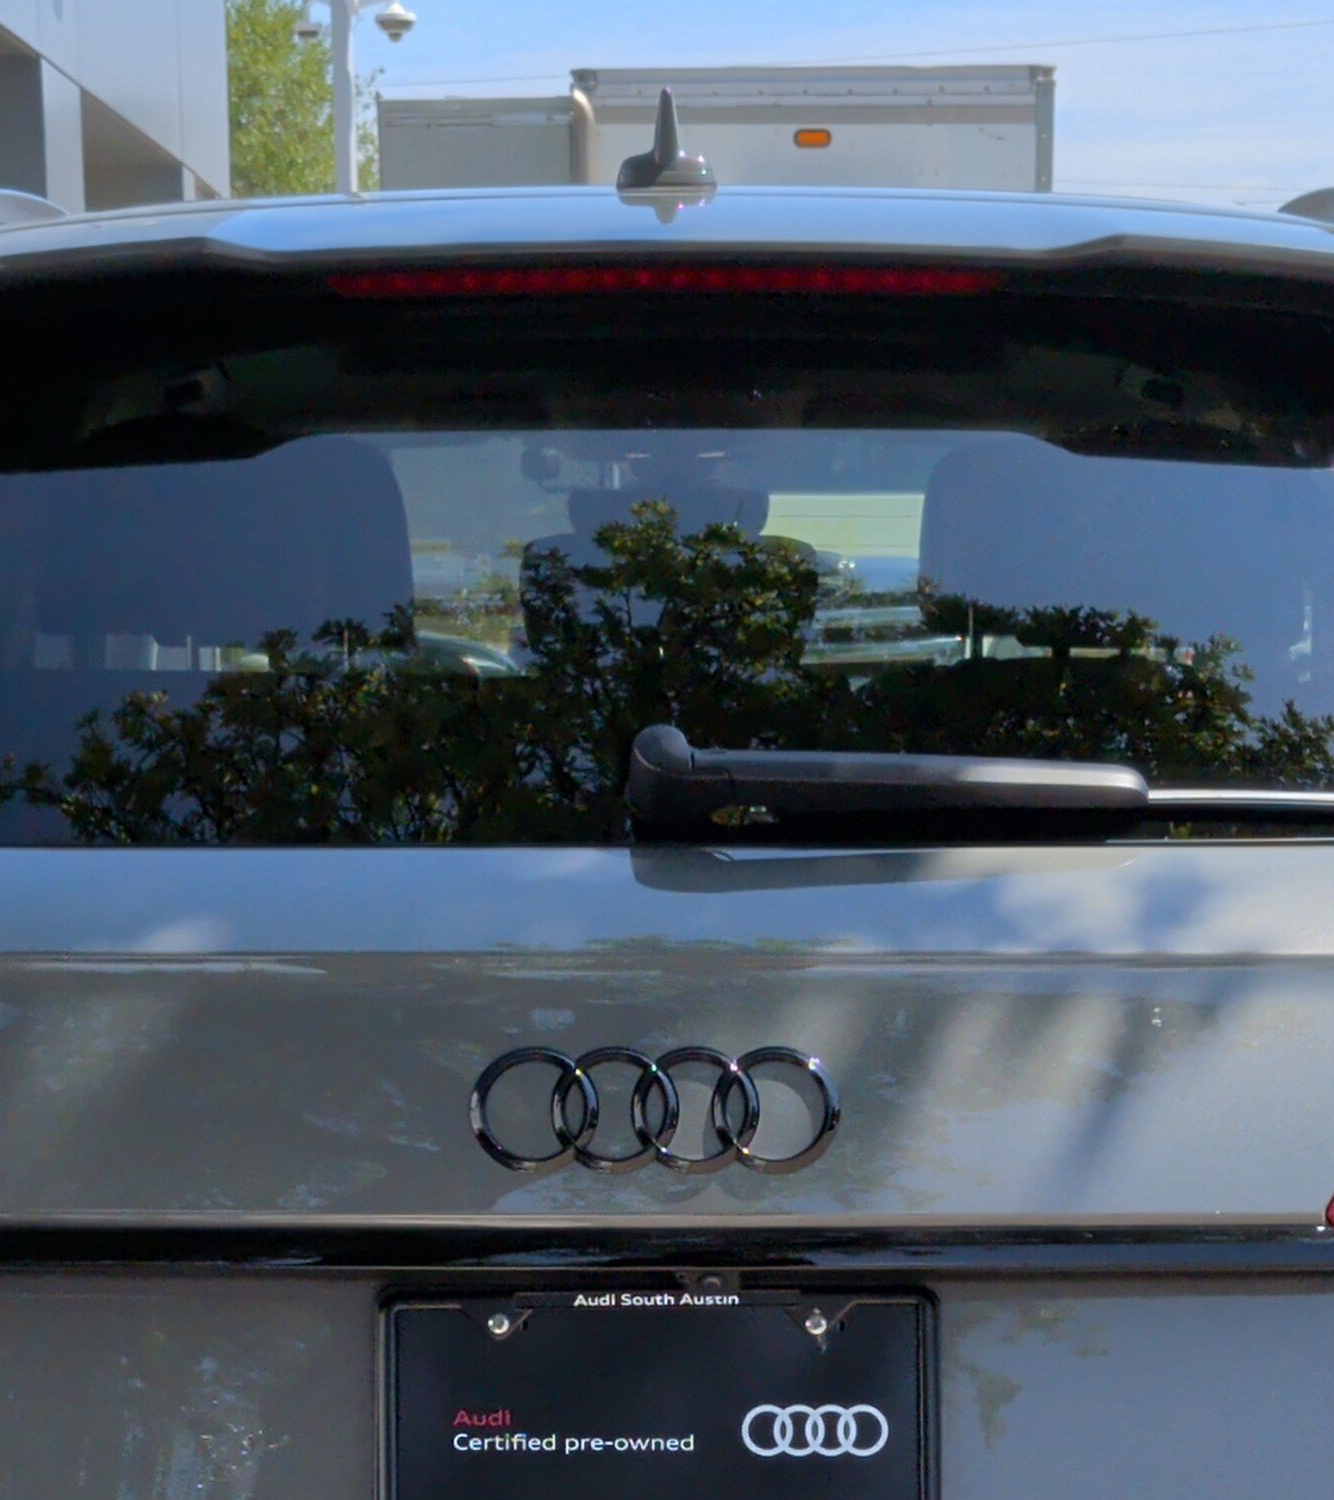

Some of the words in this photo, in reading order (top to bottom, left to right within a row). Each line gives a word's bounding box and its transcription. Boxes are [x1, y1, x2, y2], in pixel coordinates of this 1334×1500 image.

[573, 1293, 616, 1307] Audi
[621, 1293, 675, 1307] South
[679, 1292, 740, 1307] Austin
[453, 1409, 512, 1426] Audi
[453, 1433, 557, 1451] Certified
[565, 1434, 695, 1455] pre-owned
